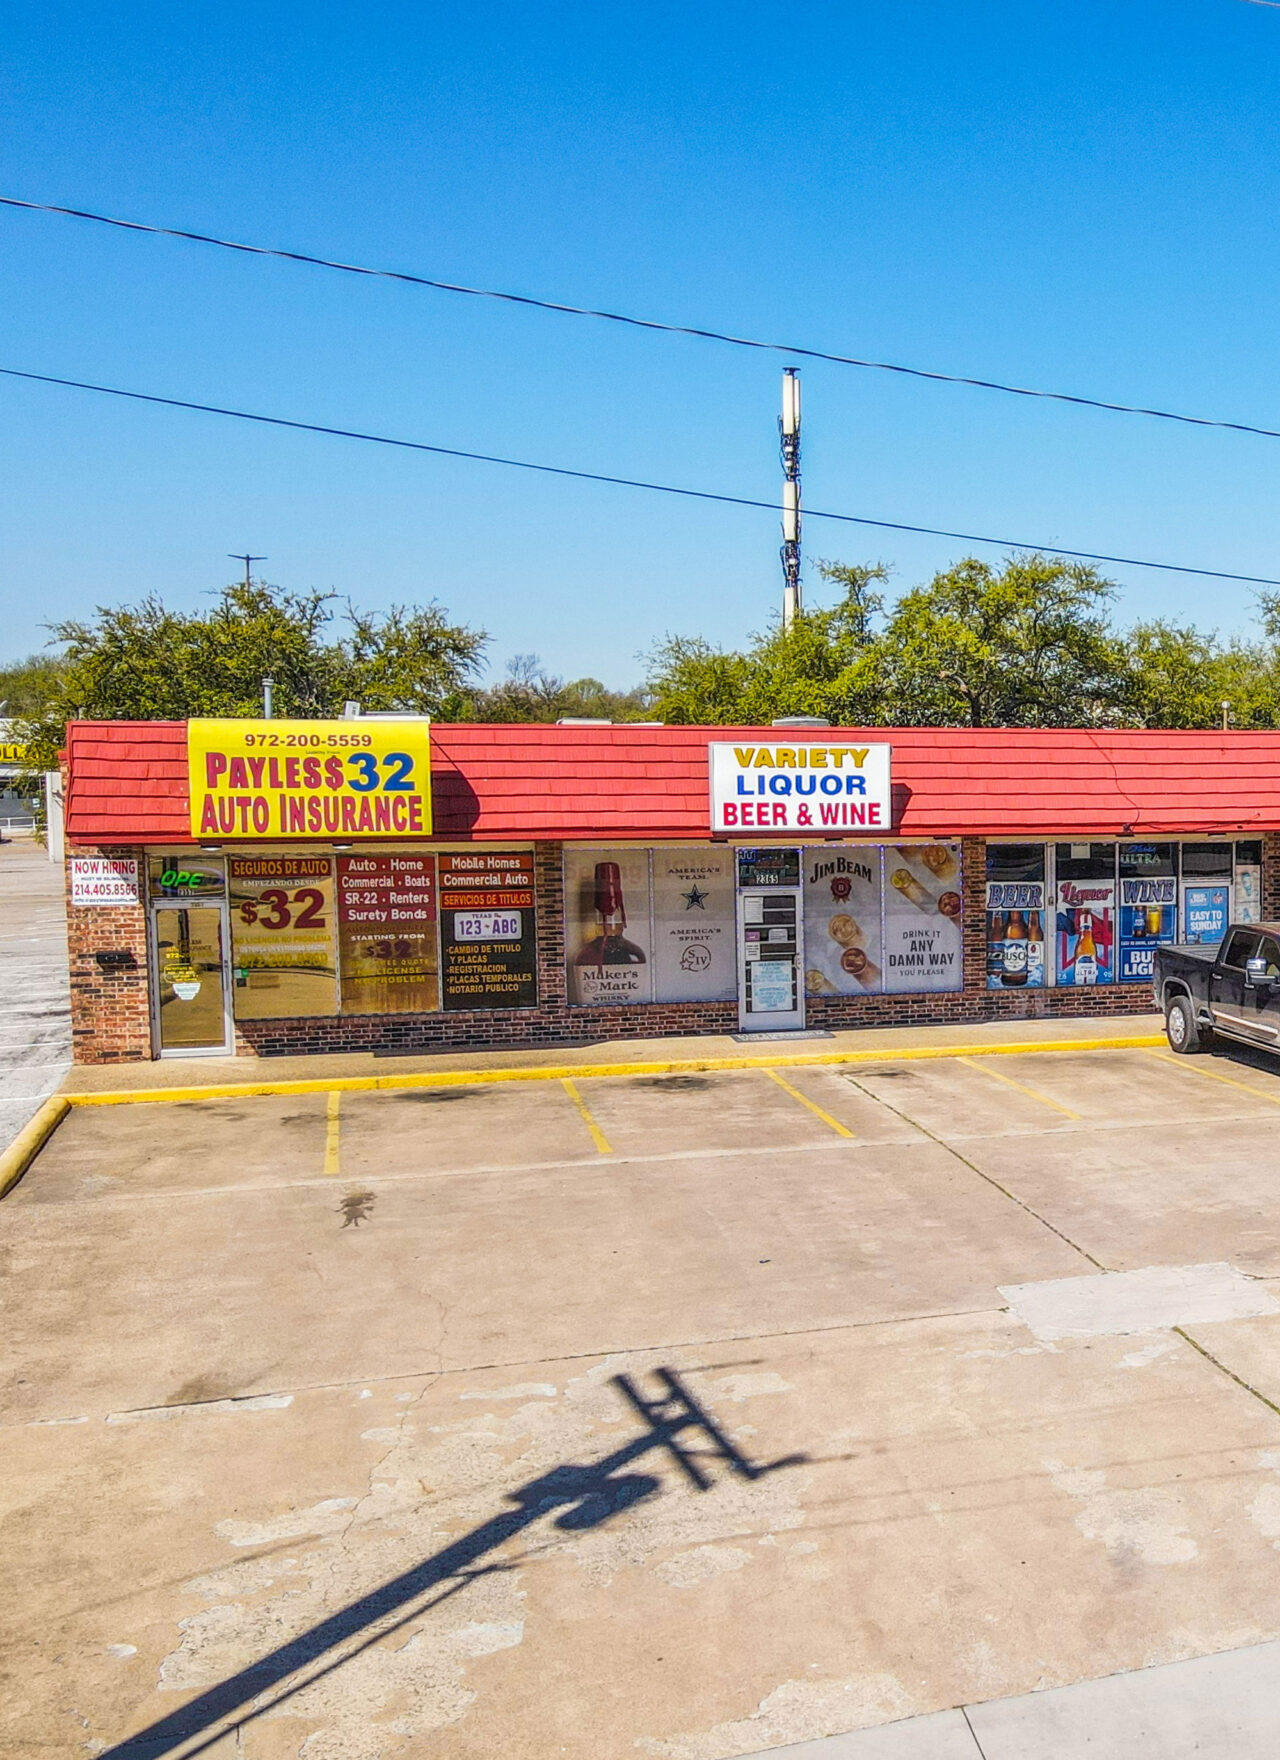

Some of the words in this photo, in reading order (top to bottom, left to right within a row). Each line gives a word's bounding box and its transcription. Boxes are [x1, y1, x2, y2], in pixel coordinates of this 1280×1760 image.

[245, 734, 372, 747] 972-200-5559
[734, 748, 869, 769] VARIETY
[737, 775, 866, 797] LIQUOR
[201, 794, 269, 834] AUTO
[280, 793, 423, 833] INSURANCE
[723, 802, 787, 826] BEER
[797, 802, 813, 826] &
[820, 802, 881, 826] WINE
[451, 857, 484, 869] Mobile
[487, 857, 520, 868] Homes
[1121, 853, 1160, 864] ULTRA
[75, 861, 99, 874] NOW
[103, 861, 135, 874] HIRING
[233, 861, 282, 875] SEGUROS
[285, 861, 298, 873] DE
[301, 860, 328, 873] AUTO
[348, 859, 377, 871] Auto
[391, 859, 424, 871] Home
[810, 861, 835, 883] JIM
[836, 856, 872, 883] BEAM
[342, 875, 394, 888] Commercial
[404, 875, 430, 886] Boats
[444, 873, 501, 886] Commercial
[505, 873, 528, 885] Auto
[756, 874, 779, 884] 2365
[345, 892, 378, 904] SR-22
[390, 892, 429, 904] Renters
[987, 884, 1042, 909] BEER
[1123, 880, 1175, 904] WINE
[444, 894, 485, 905] SERVICIOS
[487, 894, 497, 904] DE
[499, 893, 531, 904] TITULOS
[241, 888, 326, 930] $32
[348, 909, 387, 922] Surety
[391, 909, 427, 920] Bonds
[1190, 911, 1210, 921] EASY
[1211, 910, 1222, 920] TO
[459, 920, 481, 935] 123
[492, 918, 517, 934] ABC
[1190, 921, 1222, 931] SUNDAY
[902, 930, 930, 939] DRINK
[933, 930, 941, 938] IT
[448, 945, 479, 954] CAMBIO
[481, 945, 491, 953] DE
[493, 944, 521, 953] TITULO
[910, 940, 934, 952] ANY
[449, 955, 457, 963] Y
[458, 955, 487, 963] PLACAS
[889, 954, 924, 966] DAMN
[928, 952, 954, 965] WAY
[1131, 951, 1154, 963] BU
[376, 967, 421, 975] LICENSE
[583, 970, 639, 980] Maker's
[918, 968, 944, 976] PLEASE
[1124, 963, 1154, 976] LIG
[449, 975, 480, 984] PLACAS
[481, 973, 532, 982] TEMPORALES
[449, 985, 484, 994] NOTARIO
[486, 984, 519, 992] PUBLICO
[599, 981, 639, 991] Mark
